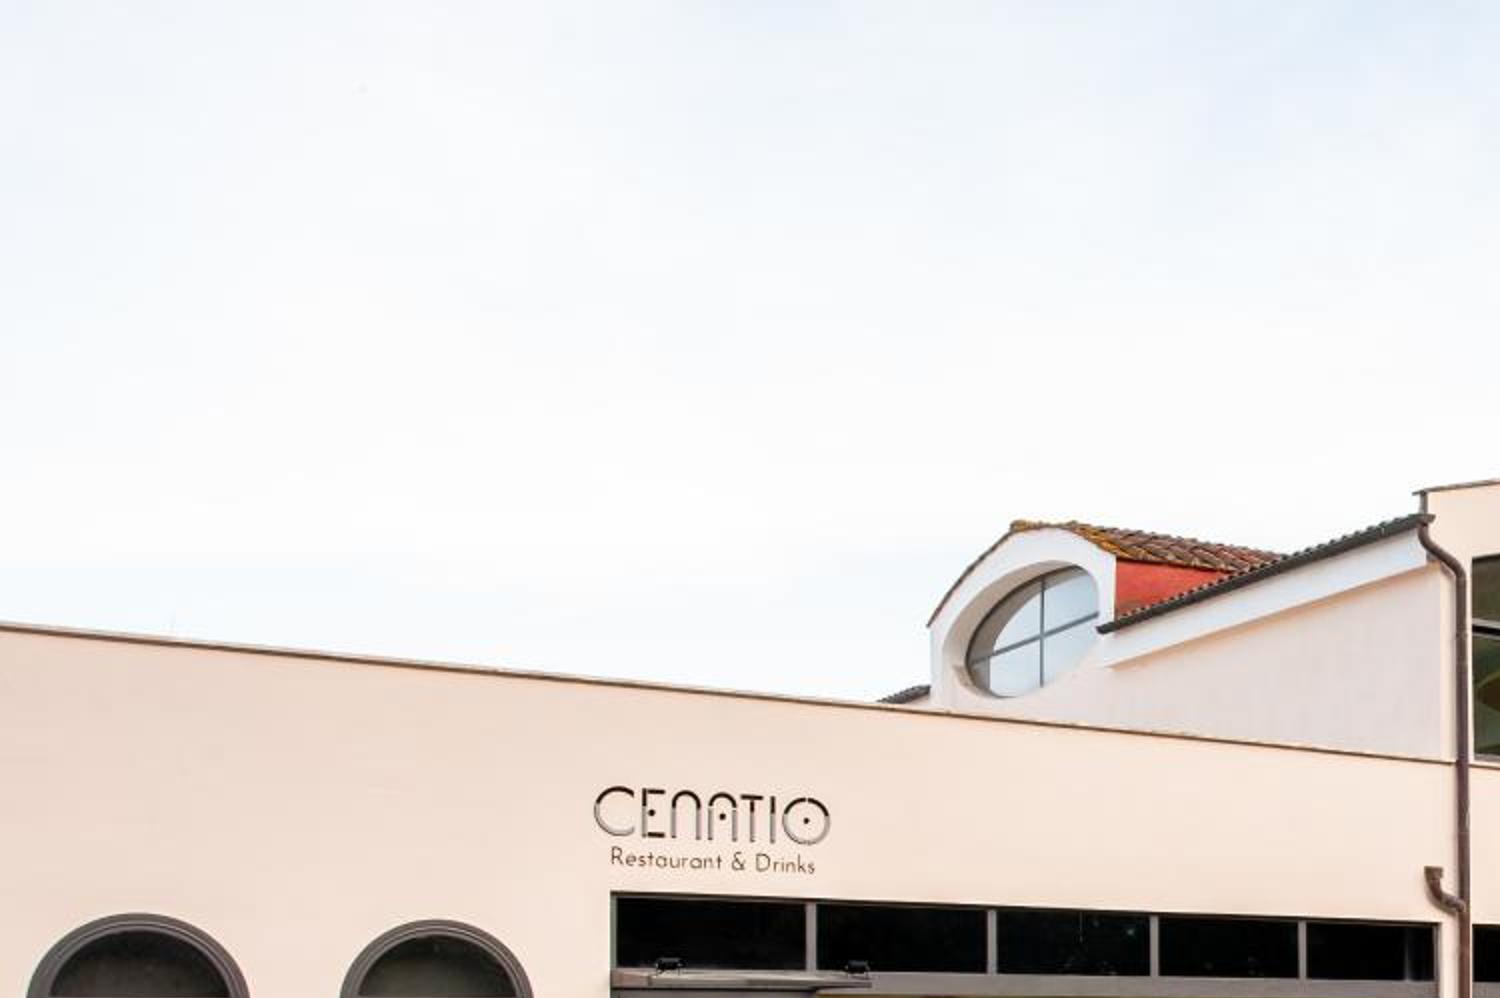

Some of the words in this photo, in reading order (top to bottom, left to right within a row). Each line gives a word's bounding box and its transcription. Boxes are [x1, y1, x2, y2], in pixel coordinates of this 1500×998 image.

[593, 786, 831, 845] CENATIO
[610, 846, 722, 869] Restaurant
[731, 851, 746, 871] &
[755, 853, 816, 874] Drinks
